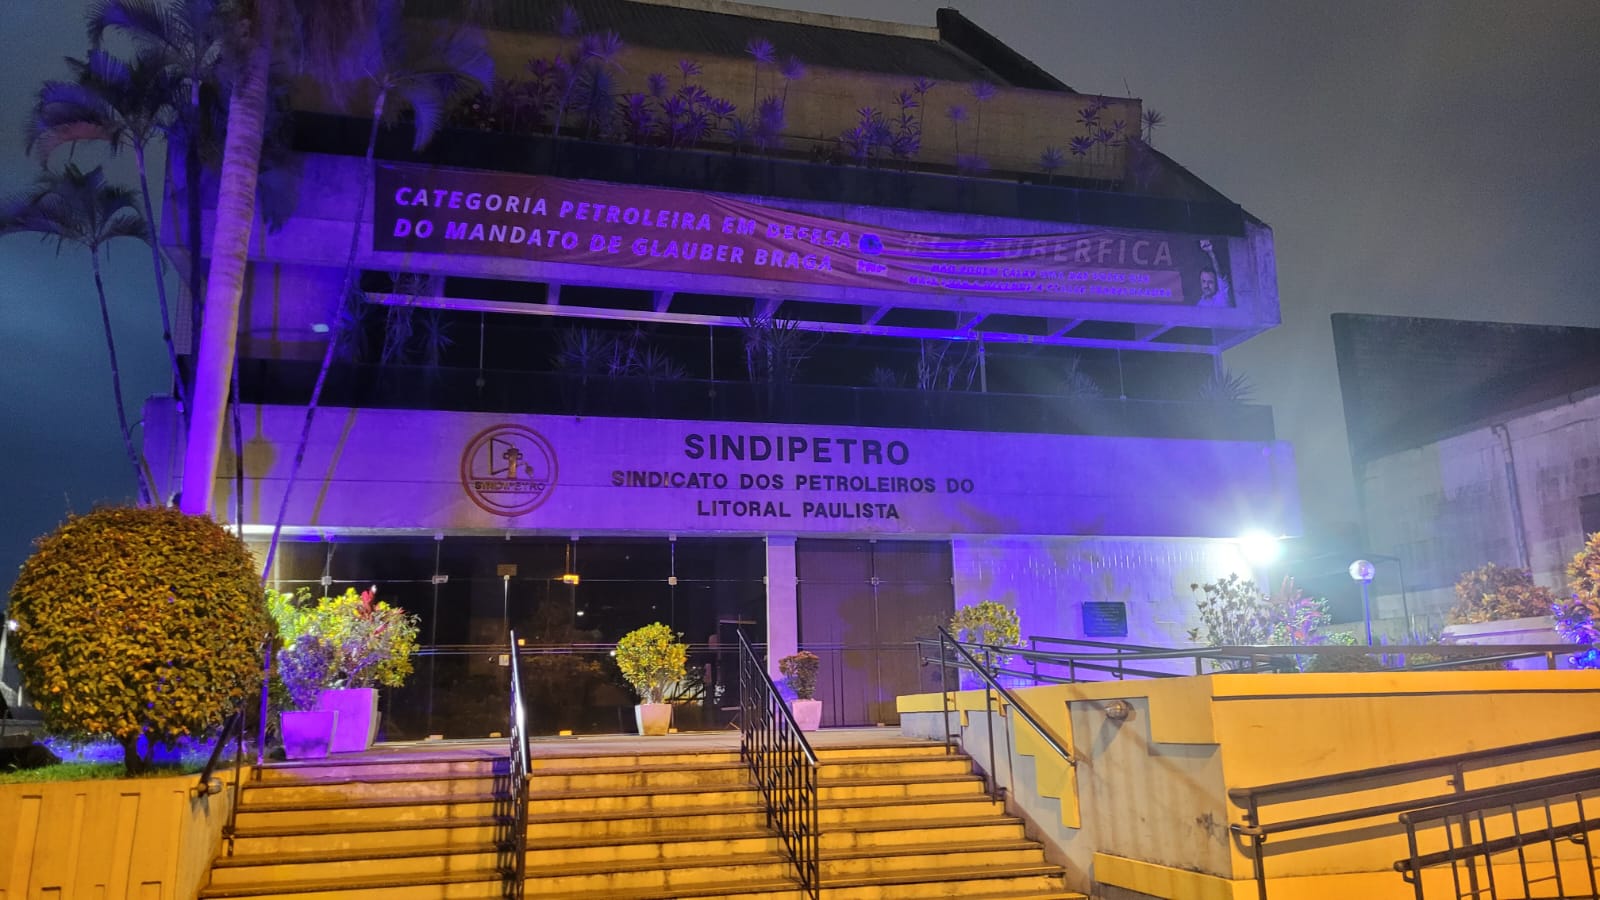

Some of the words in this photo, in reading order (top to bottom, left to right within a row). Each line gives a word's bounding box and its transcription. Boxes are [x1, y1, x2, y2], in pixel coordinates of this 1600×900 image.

[395, 187, 547, 216] CATEGORIA
[560, 200, 711, 232] PETROLEIRA
[722, 216, 756, 236] EM
[394, 218, 434, 238] DO
[445, 221, 578, 250] MANDATO
[589, 234, 622, 254] DE
[631, 238, 744, 265] GLAUBER
[754, 249, 832, 272] BRAGA
[684, 433, 909, 465] SINDIPETRO
[612, 470, 728, 490] SINDICATO
[740, 473, 784, 490] DOS
[796, 475, 936, 493] PETROLEIROS
[946, 478, 975, 493] DO
[698, 500, 791, 518] LITORAL
[803, 502, 900, 519] PAULISTA
